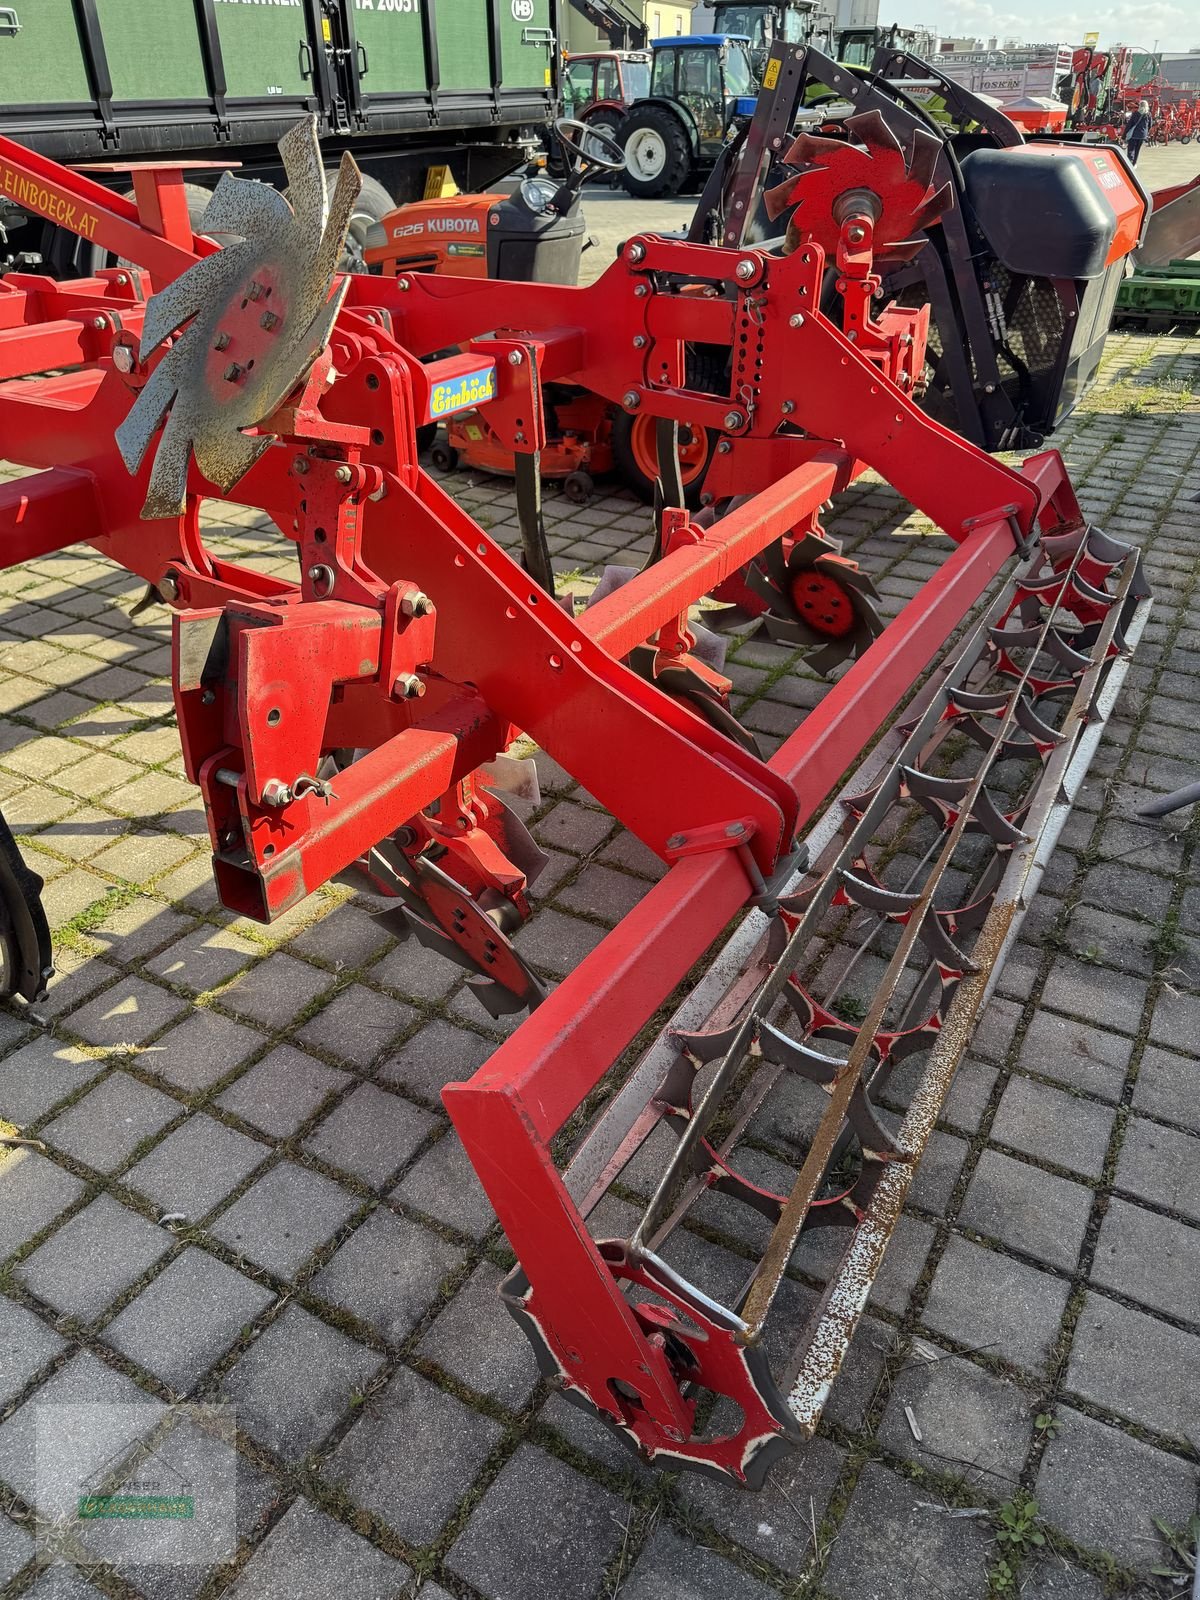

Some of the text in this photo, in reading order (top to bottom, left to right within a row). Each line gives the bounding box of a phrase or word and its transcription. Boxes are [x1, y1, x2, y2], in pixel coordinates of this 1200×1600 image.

[393, 219, 480, 238] G26 KUBOTA
[432, 371, 495, 414] Einböck
